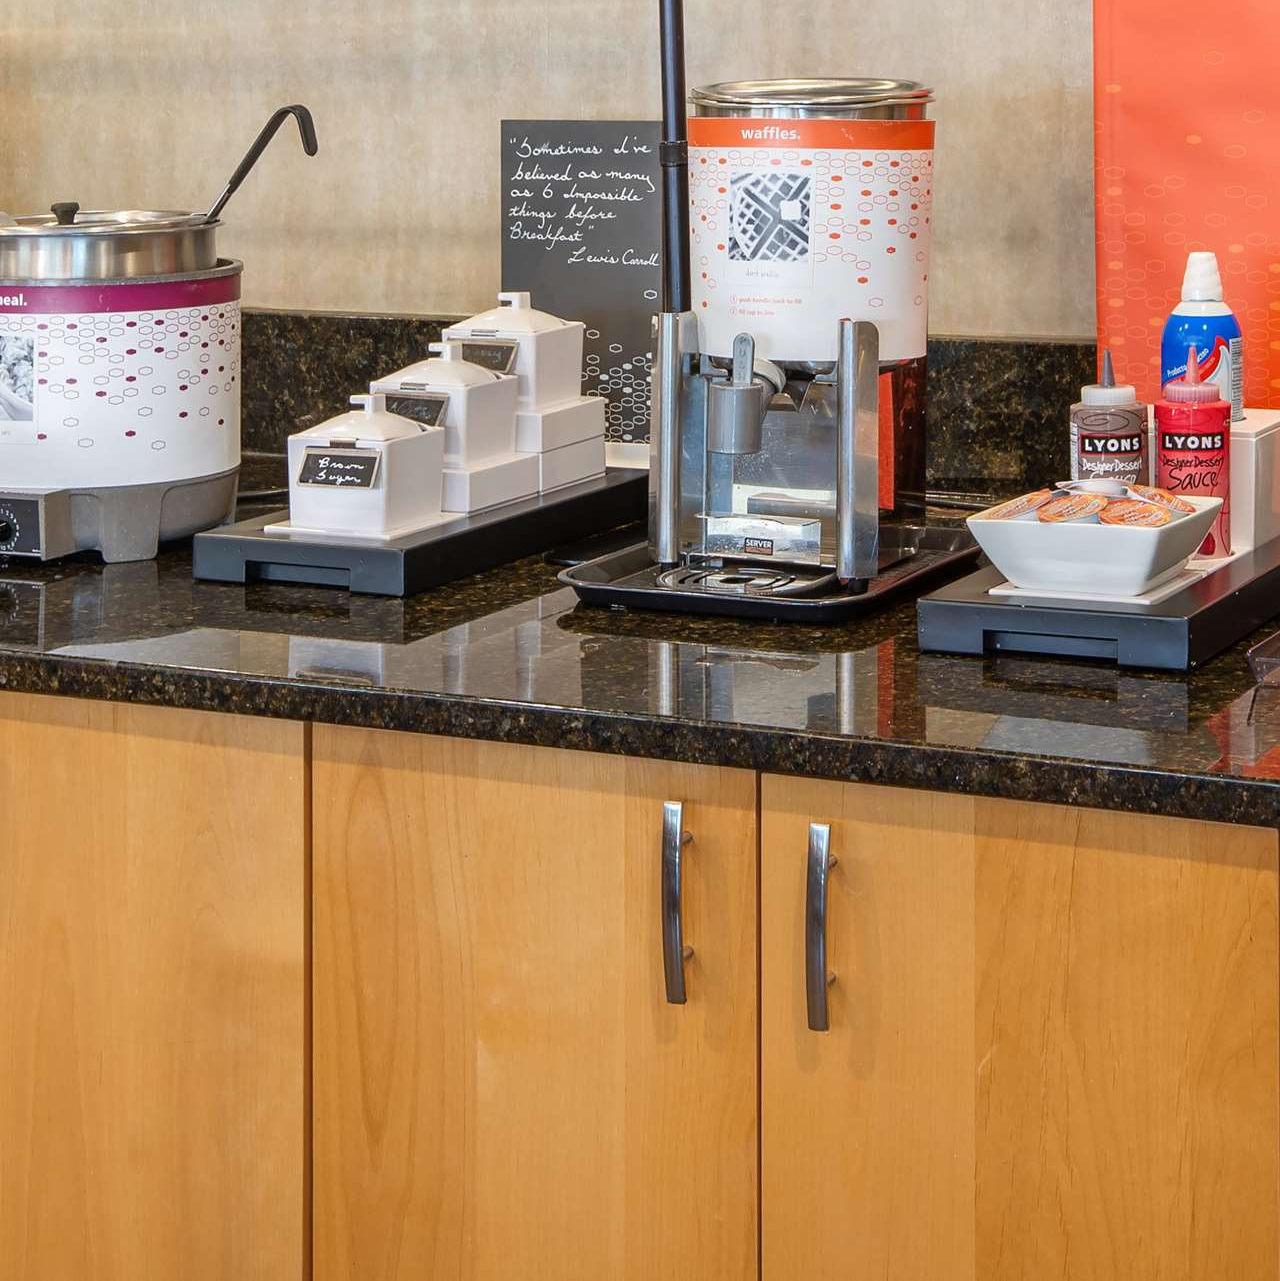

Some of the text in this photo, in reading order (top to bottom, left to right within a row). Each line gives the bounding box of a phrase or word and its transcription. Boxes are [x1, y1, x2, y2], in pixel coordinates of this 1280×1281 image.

[741, 126, 801, 140] waffles.
[511, 162, 655, 193] believed as many
[510, 189, 534, 197] as
[543, 183, 553, 198] 6
[509, 202, 616, 228] things before
[568, 247, 659, 266] Lewis Carroll
[1084, 437, 1140, 452] LYONS
[1165, 436, 1222, 449] LYONS
[1082, 458, 1114, 475] Designer
[1162, 454, 1193, 471] Designer
[1167, 468, 1219, 491] Sauce
[746, 539, 772, 548] SERVER
